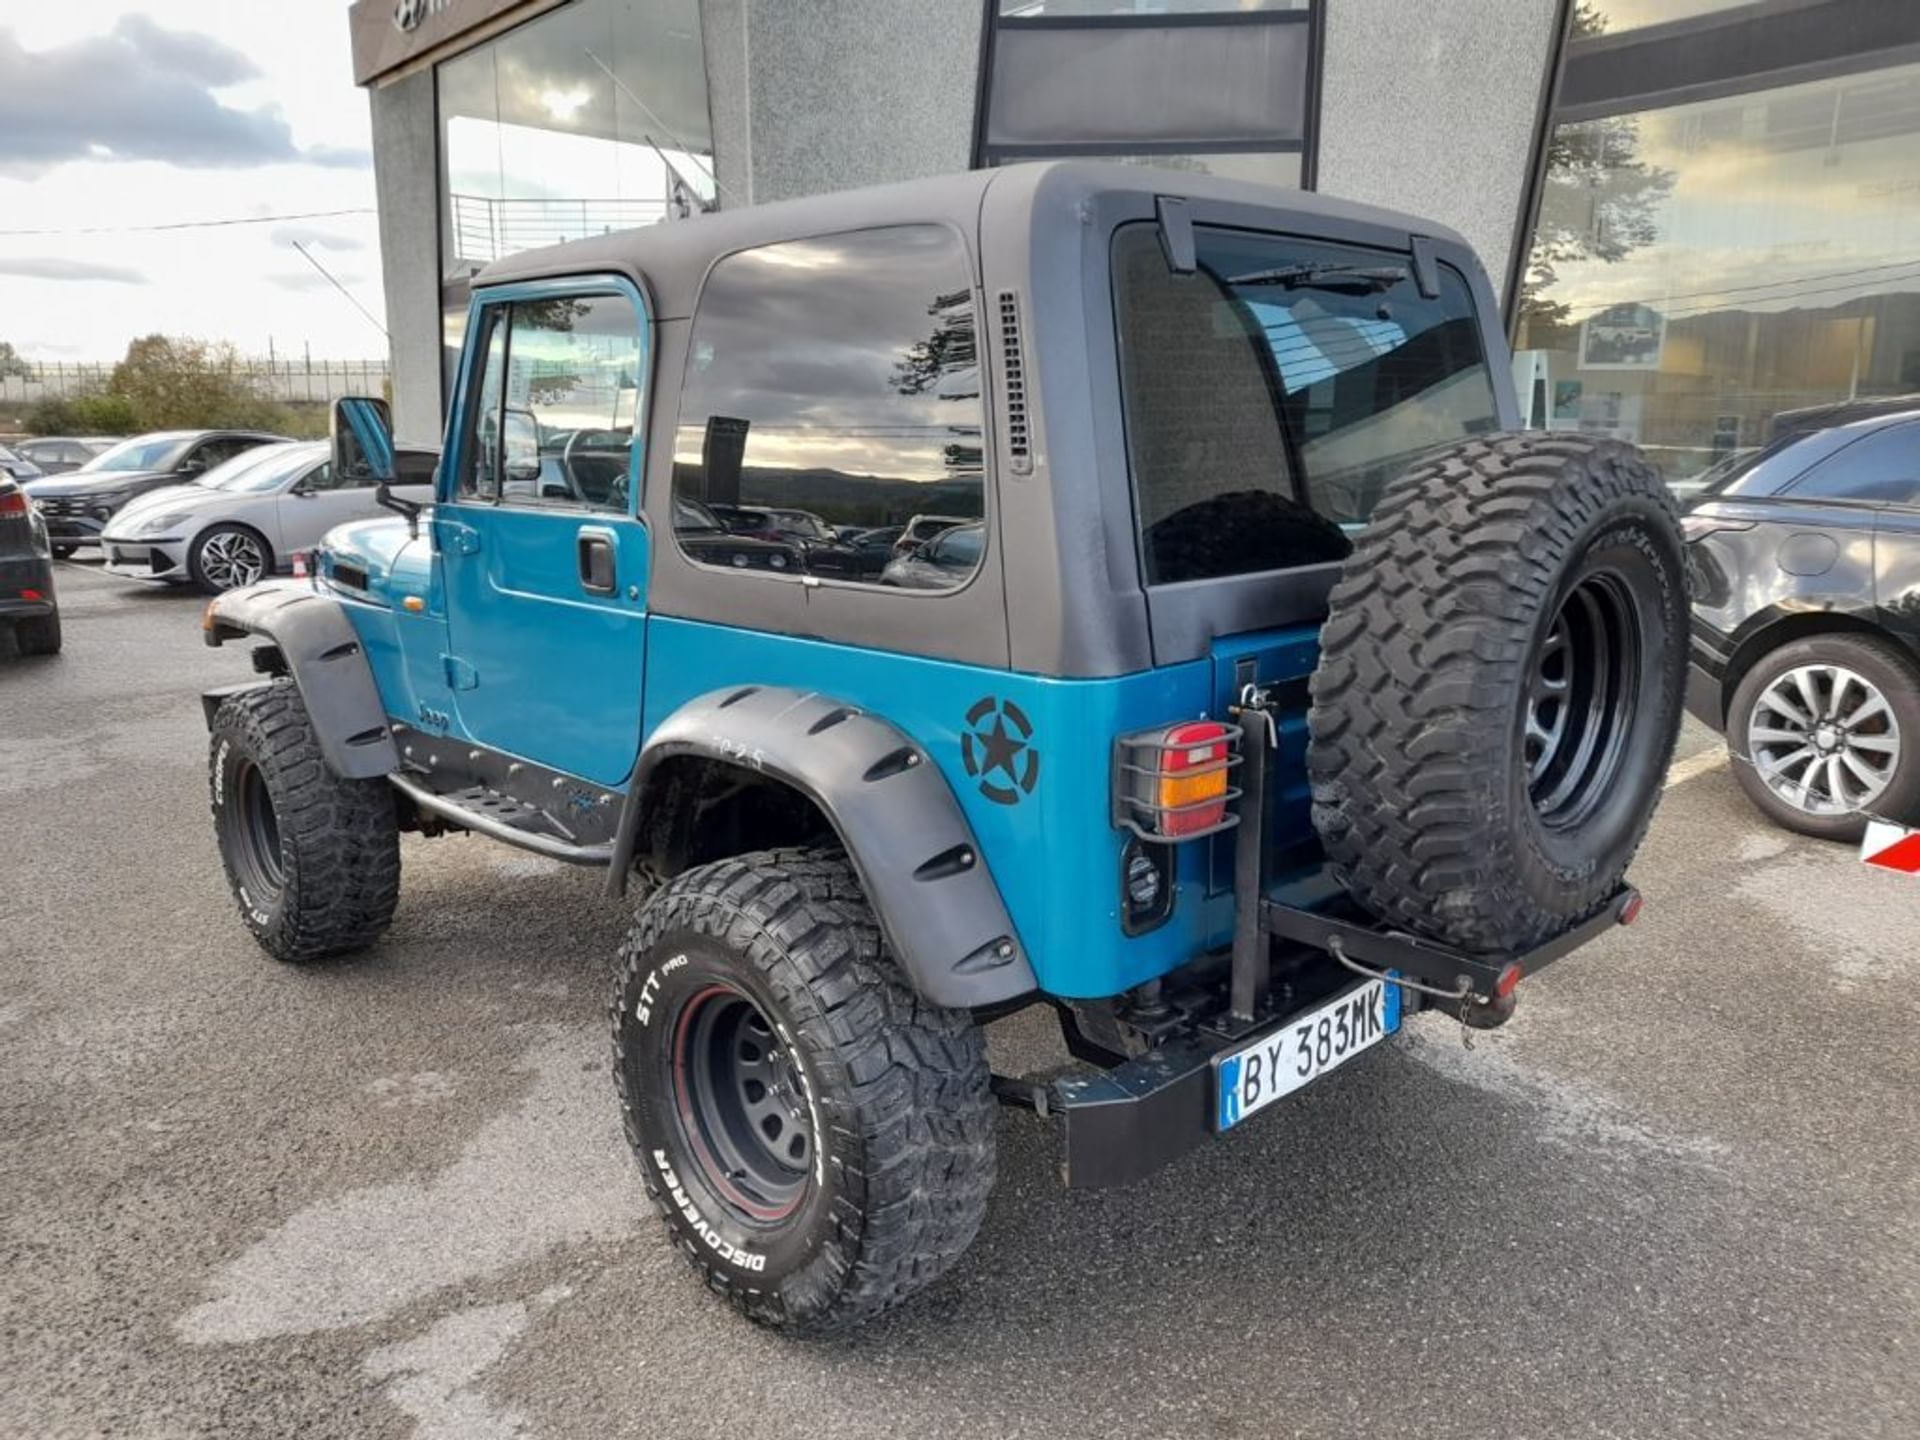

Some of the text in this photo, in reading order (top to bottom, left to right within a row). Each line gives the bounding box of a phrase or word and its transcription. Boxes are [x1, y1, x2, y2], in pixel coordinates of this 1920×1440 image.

[636, 954, 689, 1027] STT PRO
[1243, 1041, 1284, 1108] BY
[1296, 983, 1382, 1077] 383MK
[653, 1149, 766, 1272] DISCOVERER
